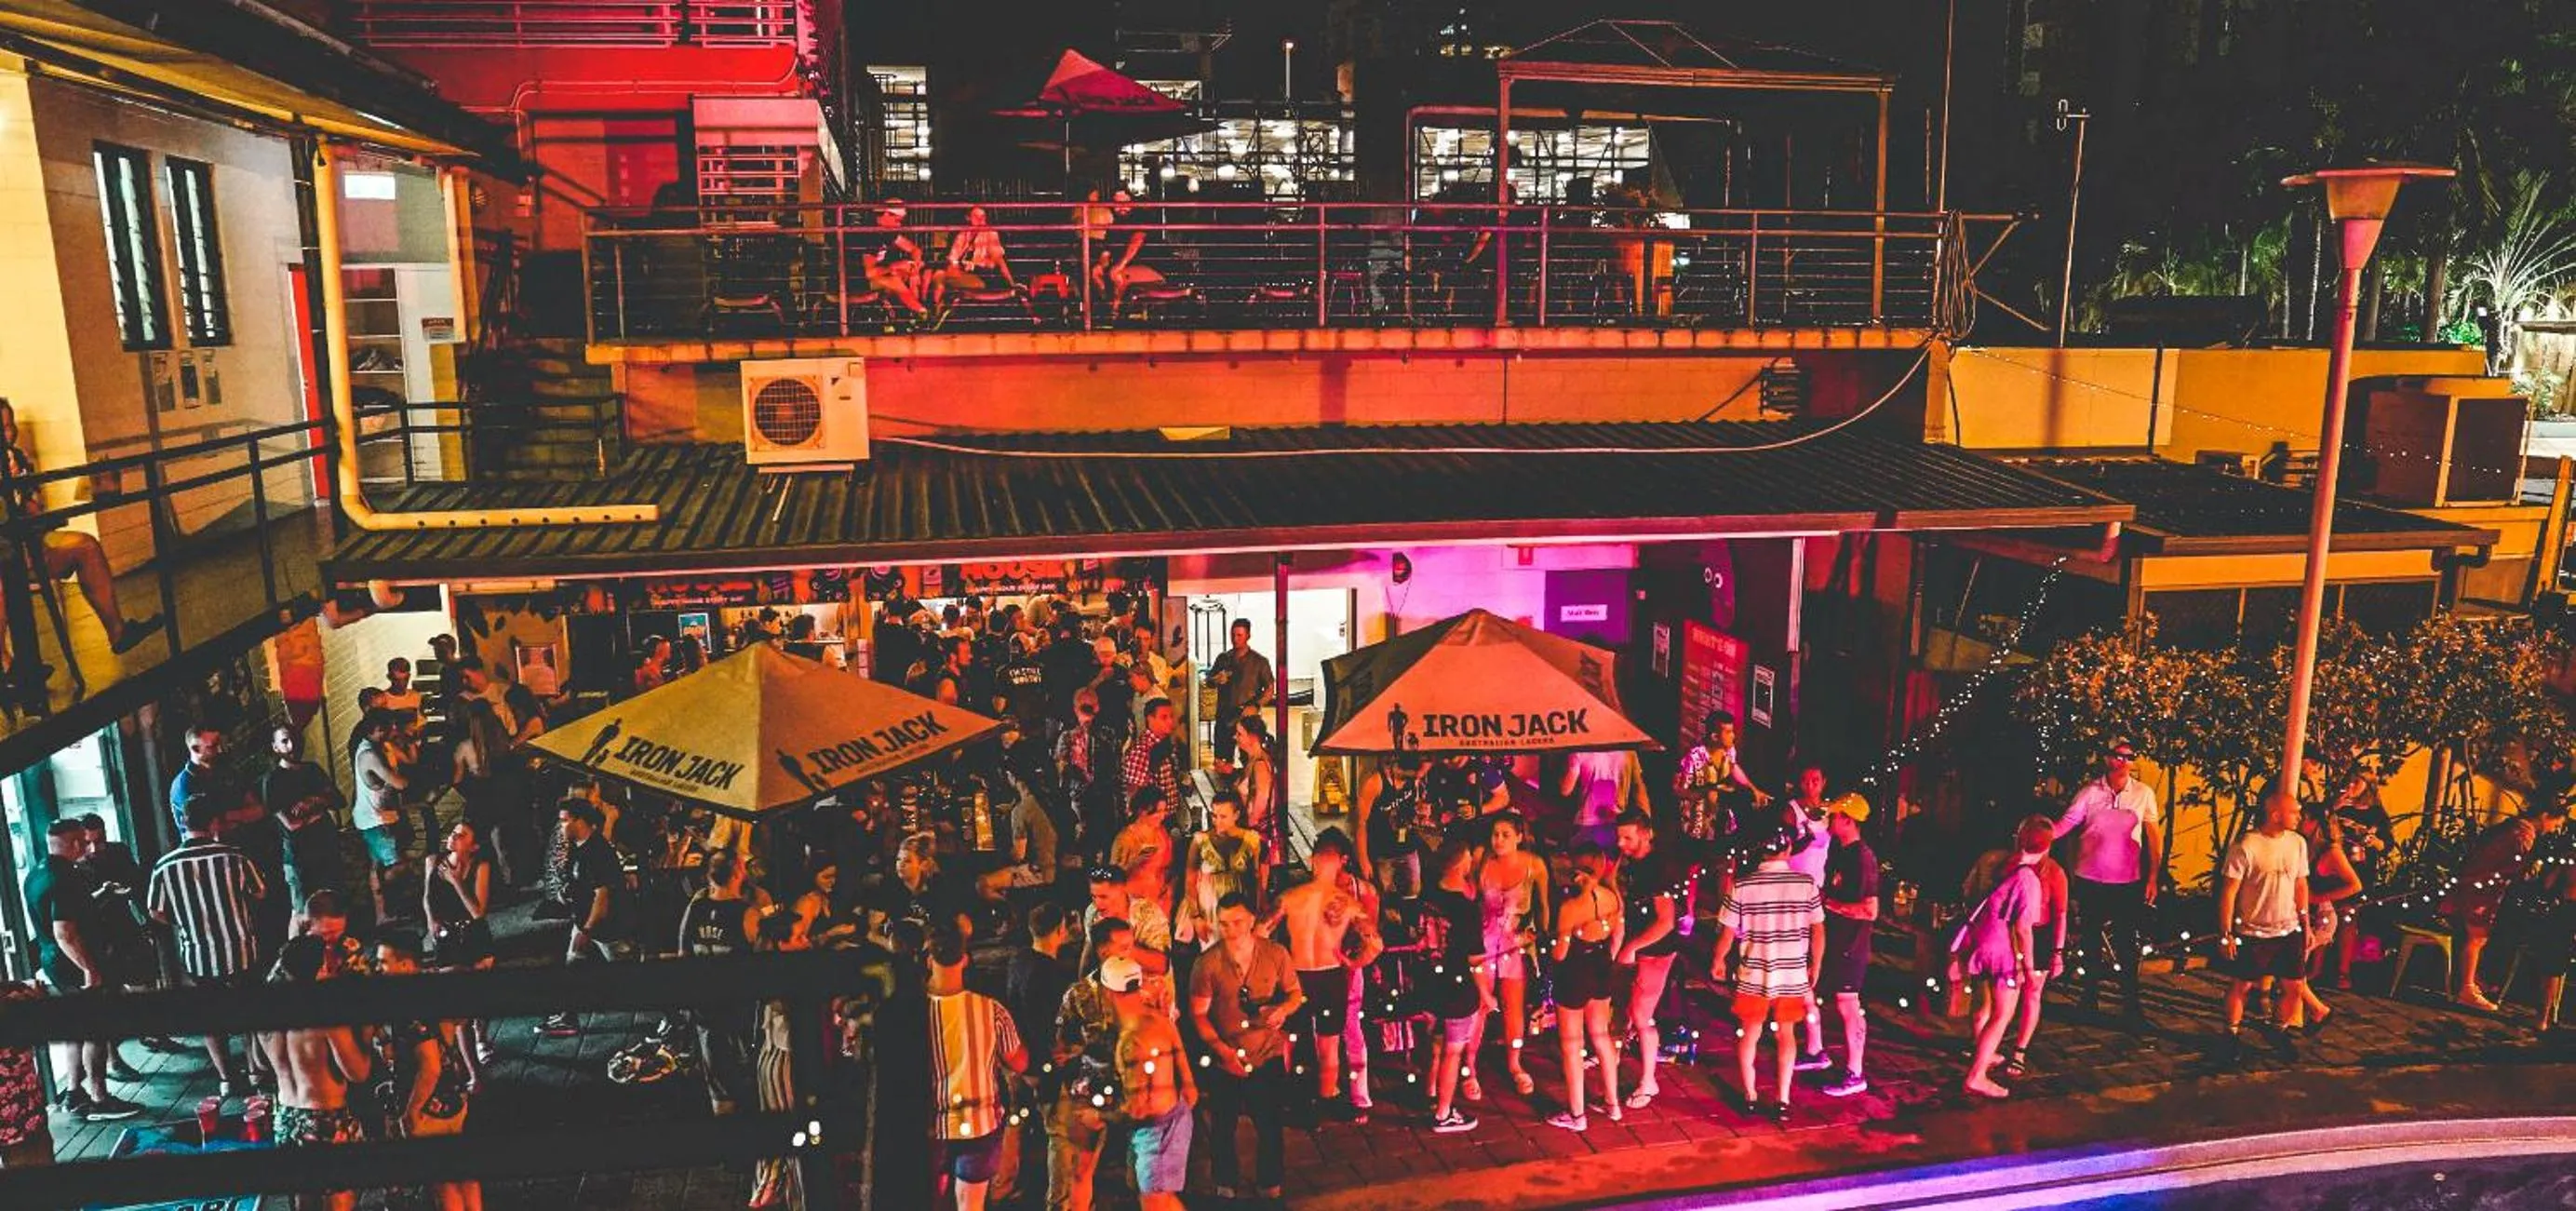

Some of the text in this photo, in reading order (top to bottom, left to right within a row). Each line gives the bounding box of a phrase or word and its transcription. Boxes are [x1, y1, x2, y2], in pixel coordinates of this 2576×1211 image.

[806, 736, 883, 774] IRON
[873, 710, 949, 752] JACK
[1423, 708, 1590, 737] IRON JACK
[614, 735, 686, 774] IRON
[675, 755, 745, 790] JACK
